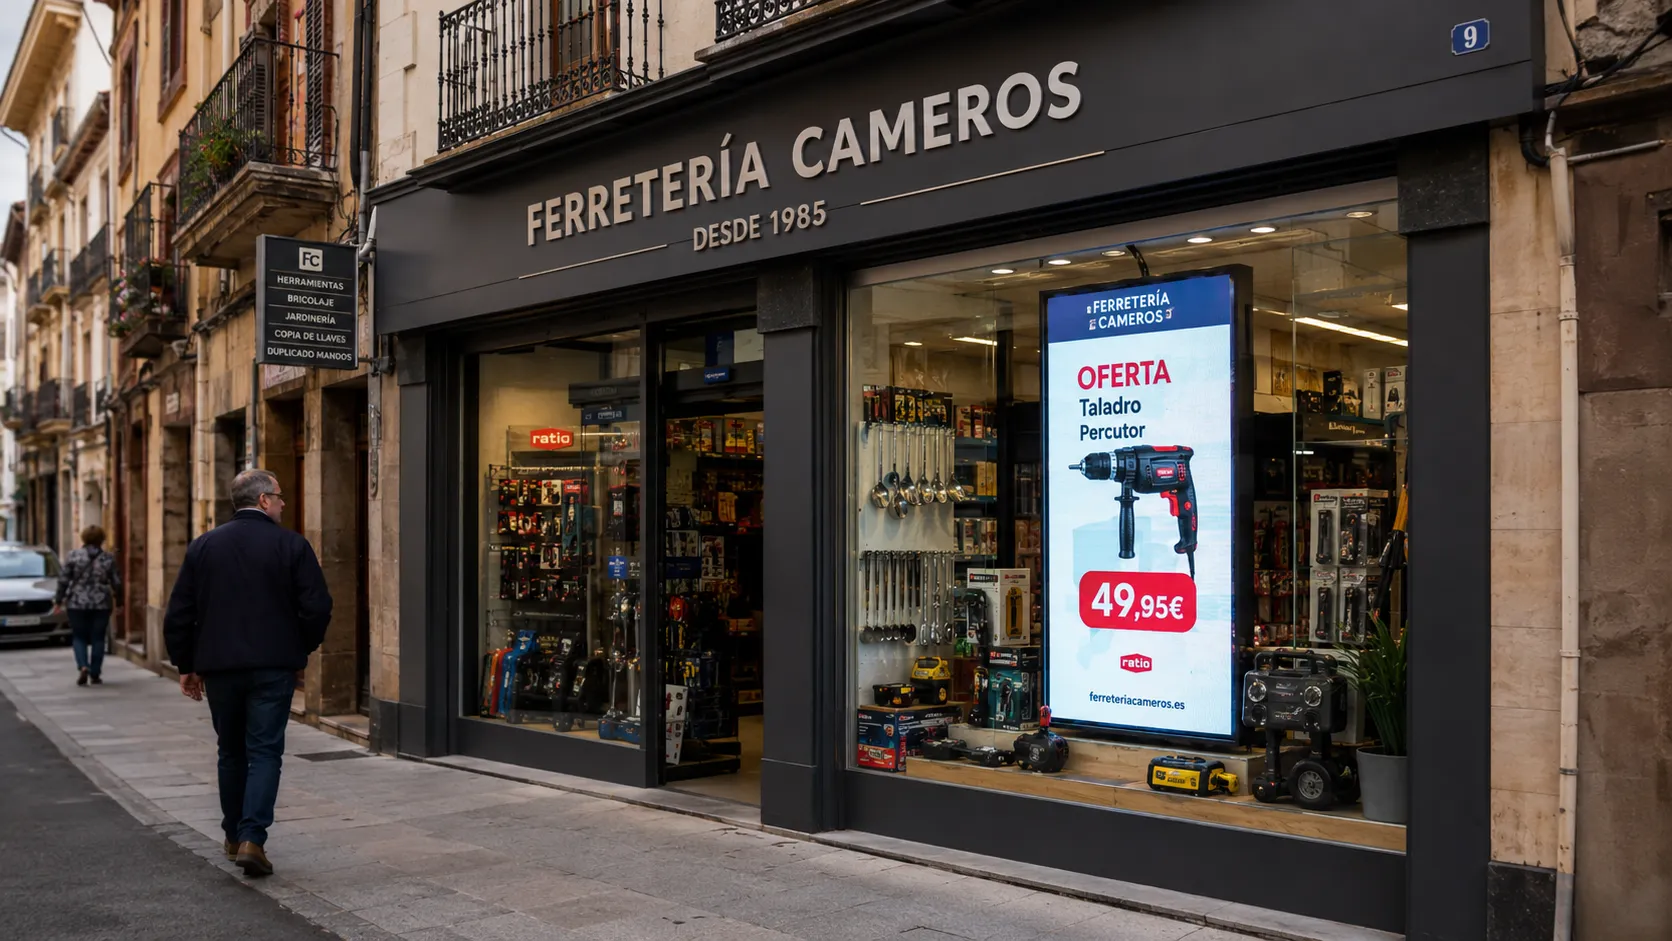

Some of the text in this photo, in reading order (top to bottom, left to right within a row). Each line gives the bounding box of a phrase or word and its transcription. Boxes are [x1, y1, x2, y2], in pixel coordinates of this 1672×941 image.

[1464, 25, 1477, 48] 9
[527, 60, 1082, 247] FERRETERÍA CAMEROS
[693, 200, 827, 252] DESDE 1985
[302, 251, 320, 267] FC
[277, 275, 344, 290] HERRAMIENTAS
[287, 294, 334, 307] BRICOLAJE
[1093, 289, 1170, 314] FERRETERÍA
[285, 312, 336, 324] JARDINERÍA
[1098, 310, 1163, 329] CAMEROS
[274, 329, 346, 343] COPIA DE LLAVES
[267, 347, 352, 361] DUPLICADO MANDOS
[1077, 359, 1172, 390] OFERTA
[1079, 396, 1141, 416] Taladro
[532, 432, 570, 444] ratio
[1080, 423, 1145, 441] Percutor
[1091, 582, 1184, 622] 49,95€
[1122, 658, 1151, 668] ratio
[1089, 691, 1185, 710] ferreteriacameros.es
